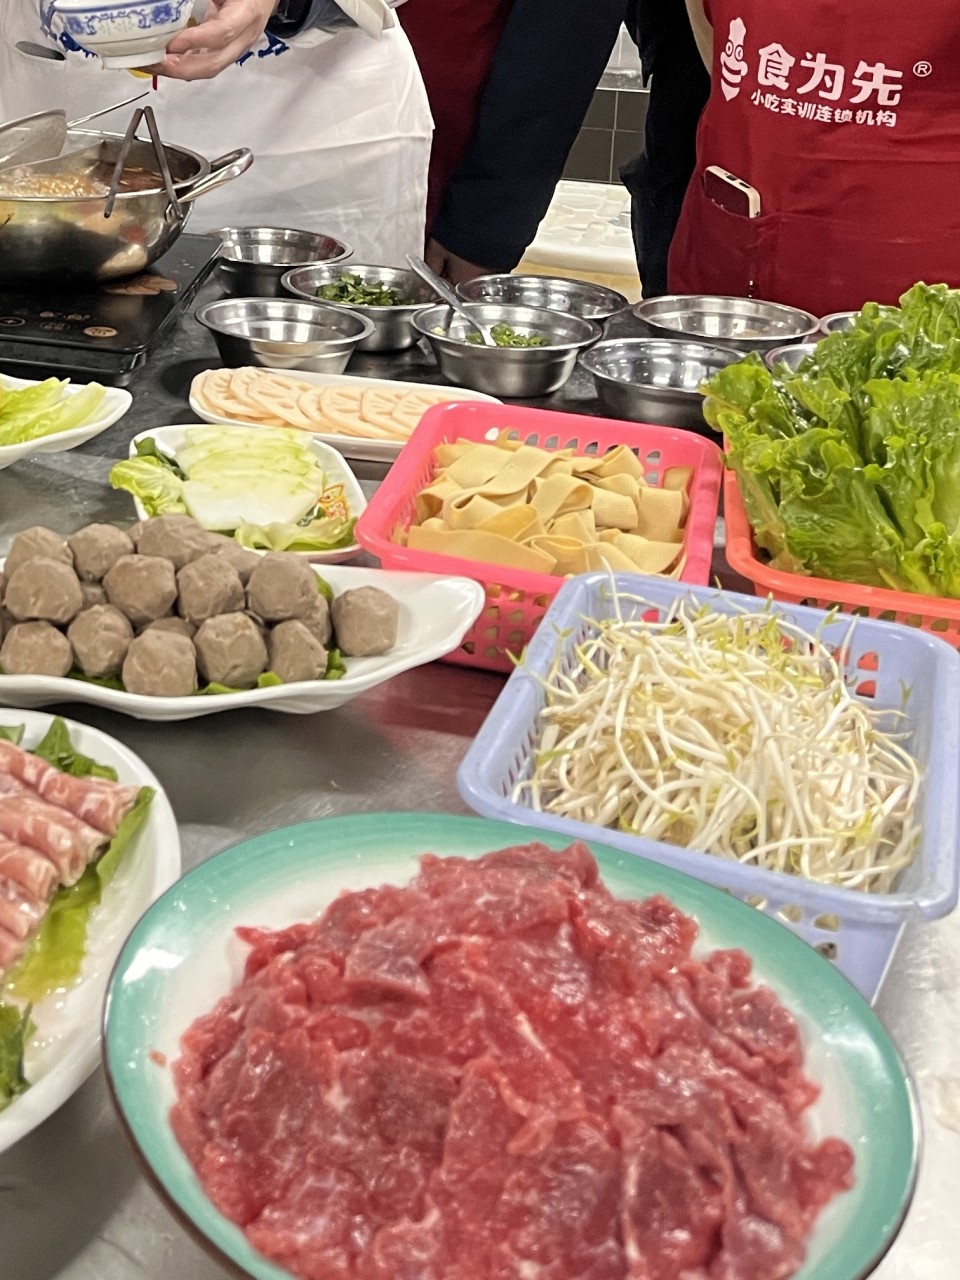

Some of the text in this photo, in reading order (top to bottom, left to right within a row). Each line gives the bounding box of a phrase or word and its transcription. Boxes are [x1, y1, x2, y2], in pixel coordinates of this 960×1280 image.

[757, 42, 903, 106] 食为先
[750, 88, 898, 128] 小吃实训连锁机构
